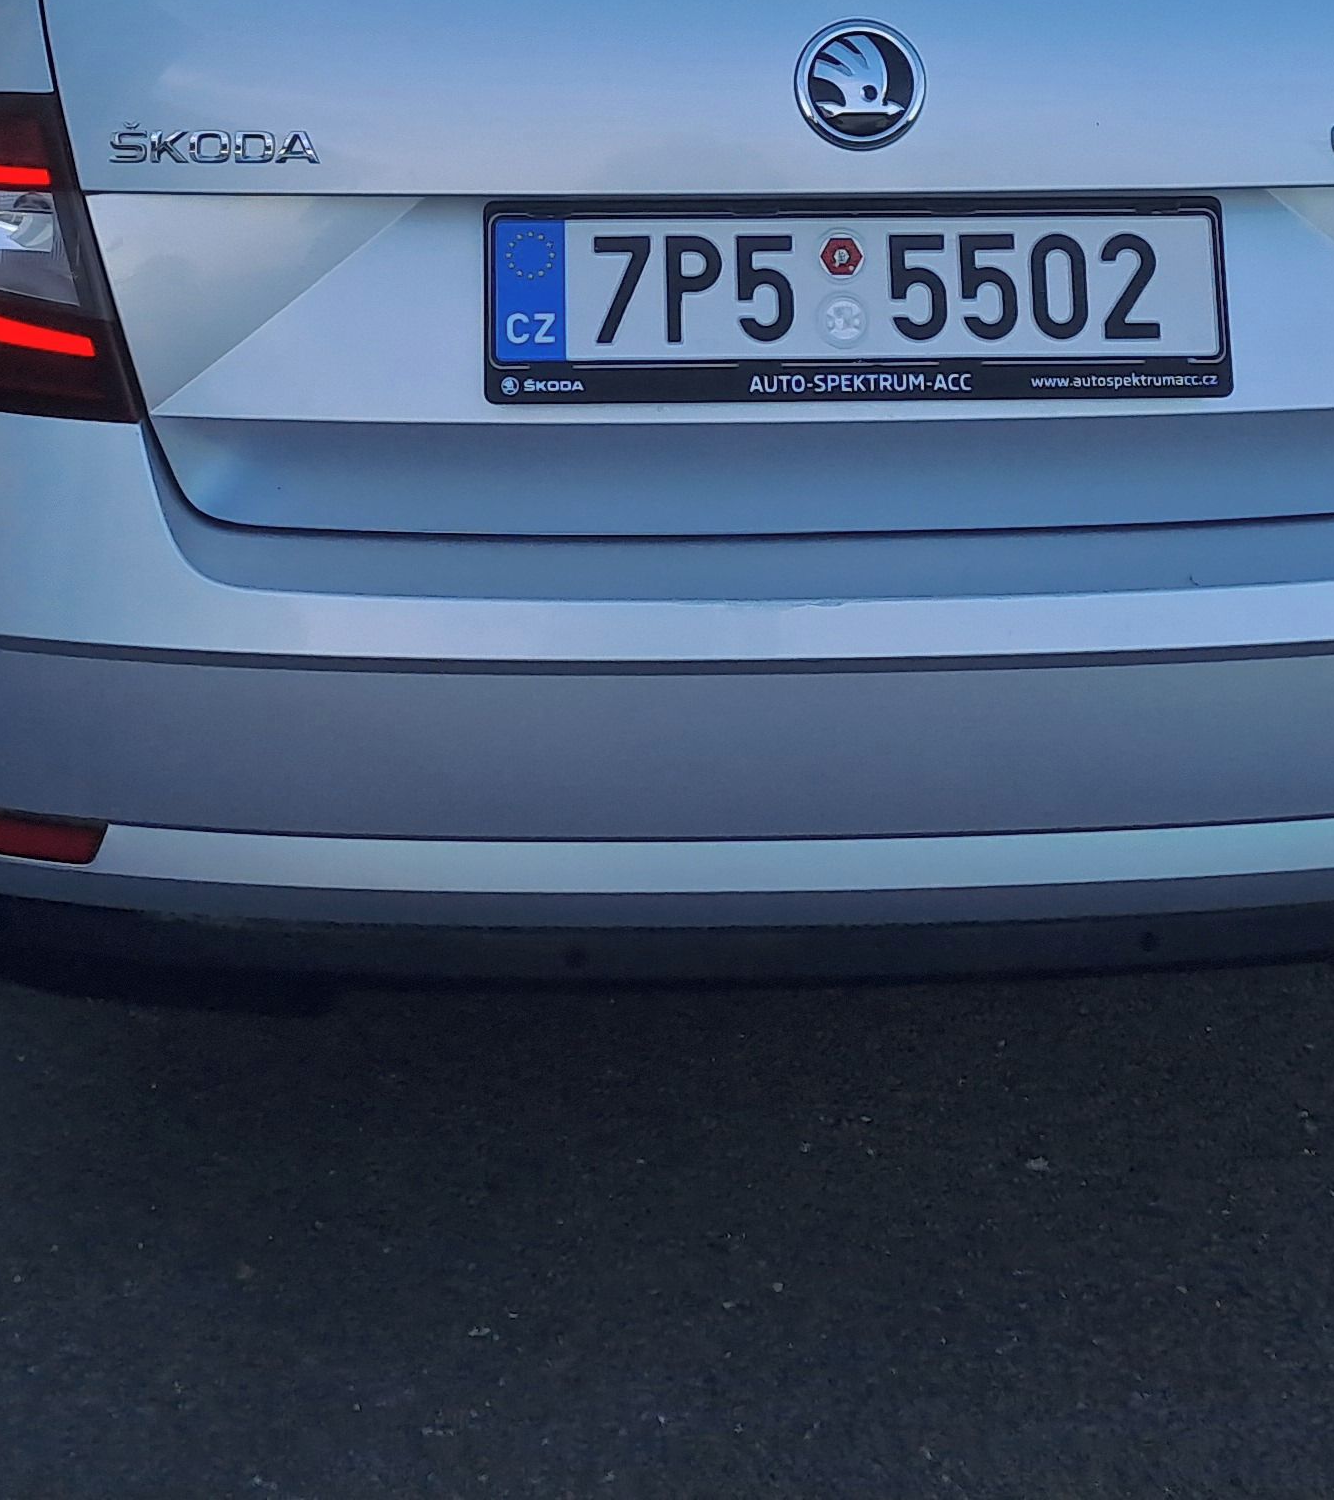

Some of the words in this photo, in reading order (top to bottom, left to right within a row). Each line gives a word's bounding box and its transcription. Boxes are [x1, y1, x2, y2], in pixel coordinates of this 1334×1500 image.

[109, 122, 321, 164] ŠKODA
[592, 234, 795, 346] 7P5
[887, 231, 1162, 342] 5502
[505, 312, 556, 345] CZ
[522, 378, 585, 392] ŠKODA
[749, 373, 972, 393] AUTO-SPEKTRUM-ACC
[1030, 372, 1219, 390] www.autospektrumacc.cz
